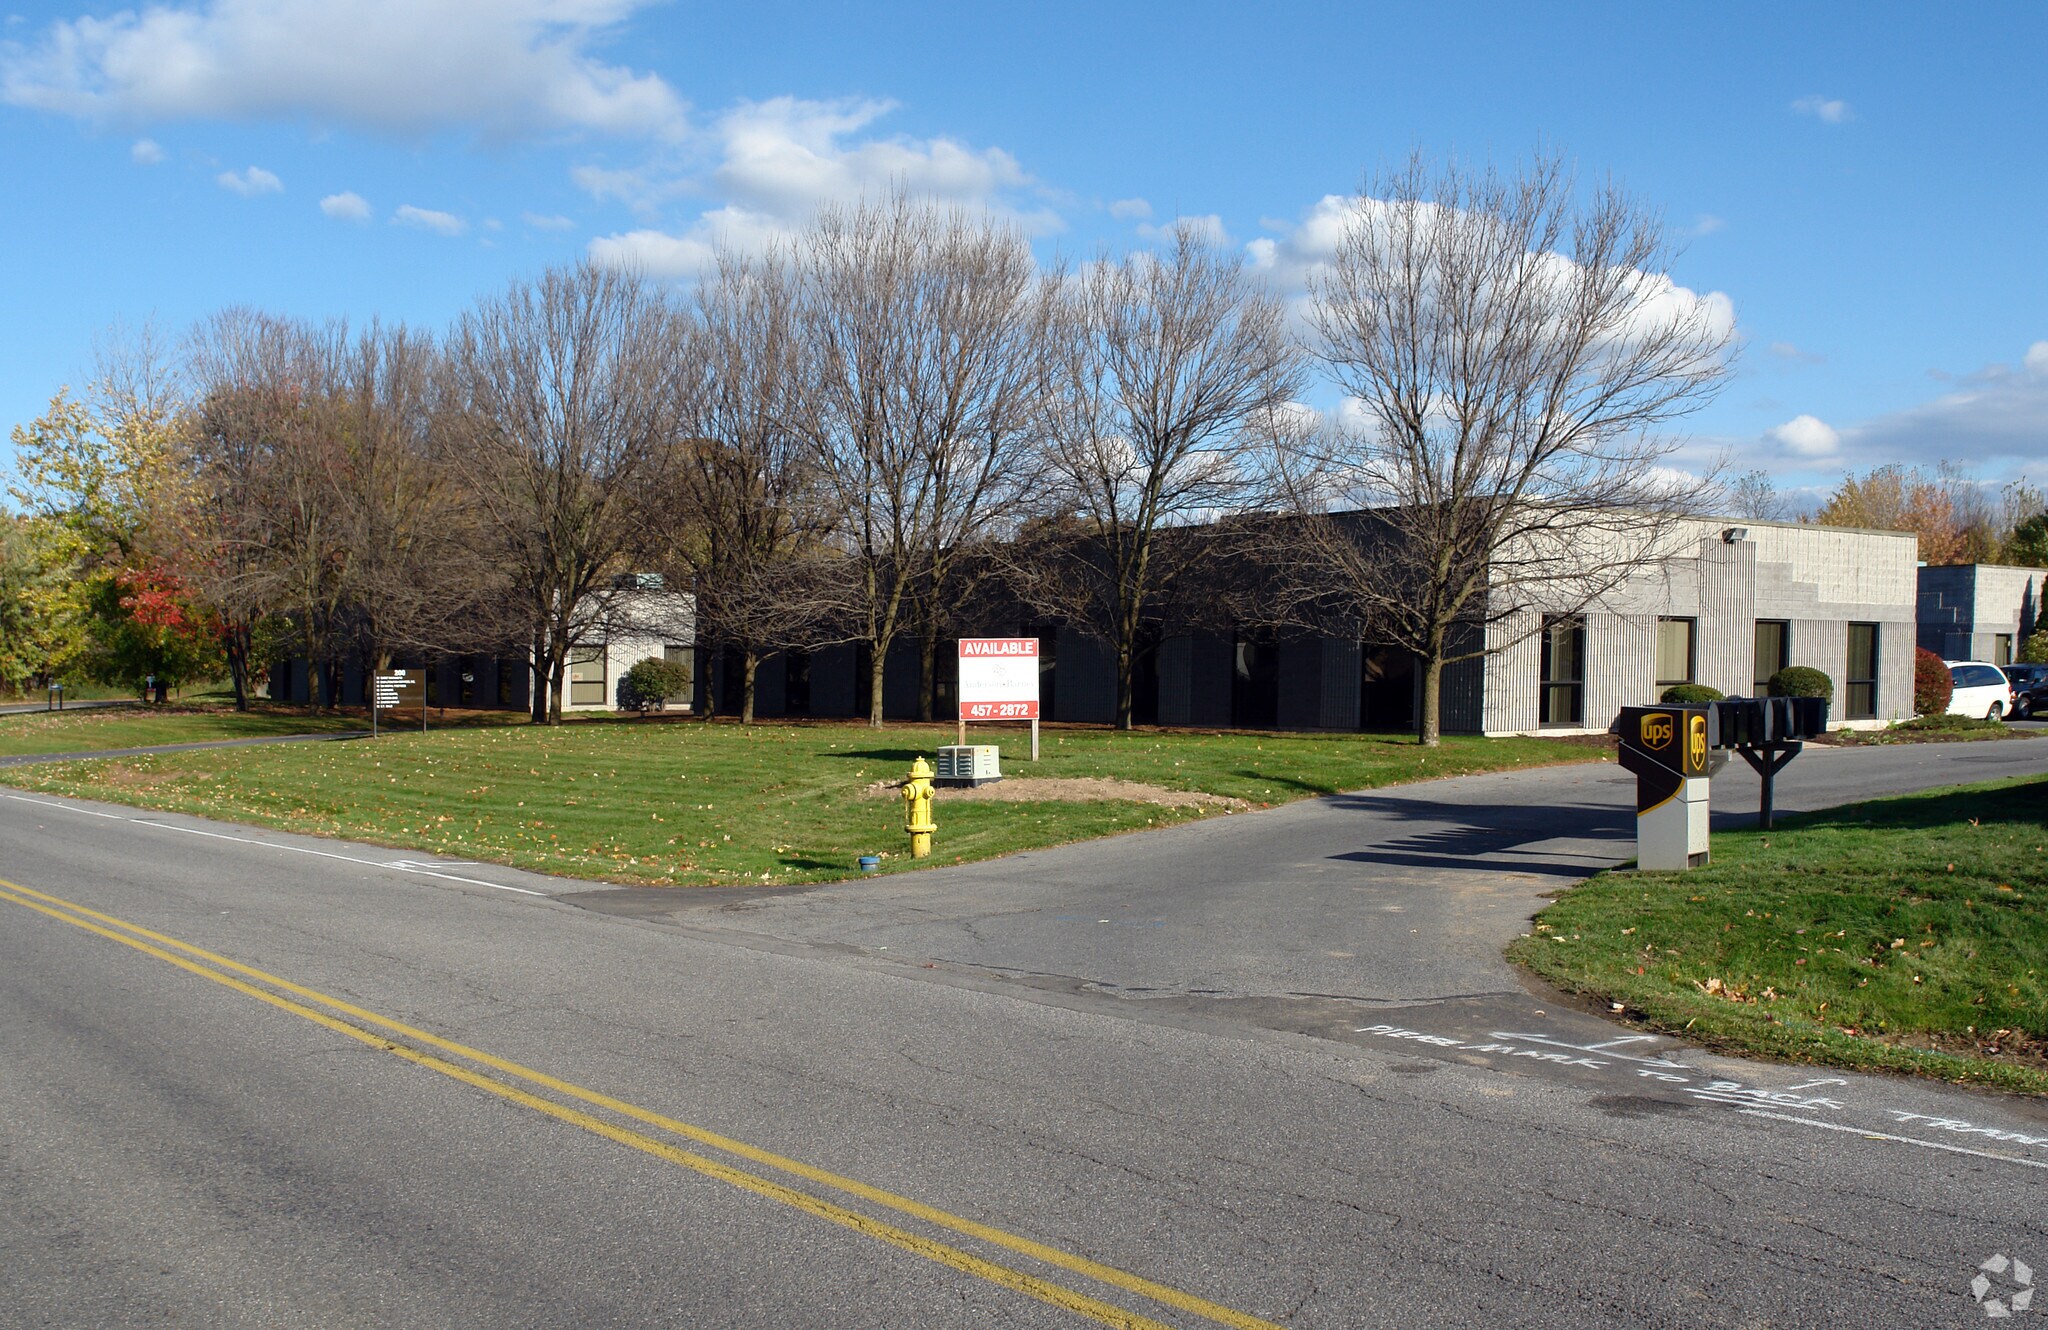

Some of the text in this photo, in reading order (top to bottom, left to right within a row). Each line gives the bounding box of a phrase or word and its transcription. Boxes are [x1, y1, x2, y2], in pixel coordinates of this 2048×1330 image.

[964, 642, 1034, 655] AVAILABLE
[1643, 724, 1671, 745] ups
[1692, 733, 1705, 762] ups
[1637, 1069, 1690, 1082] TO
